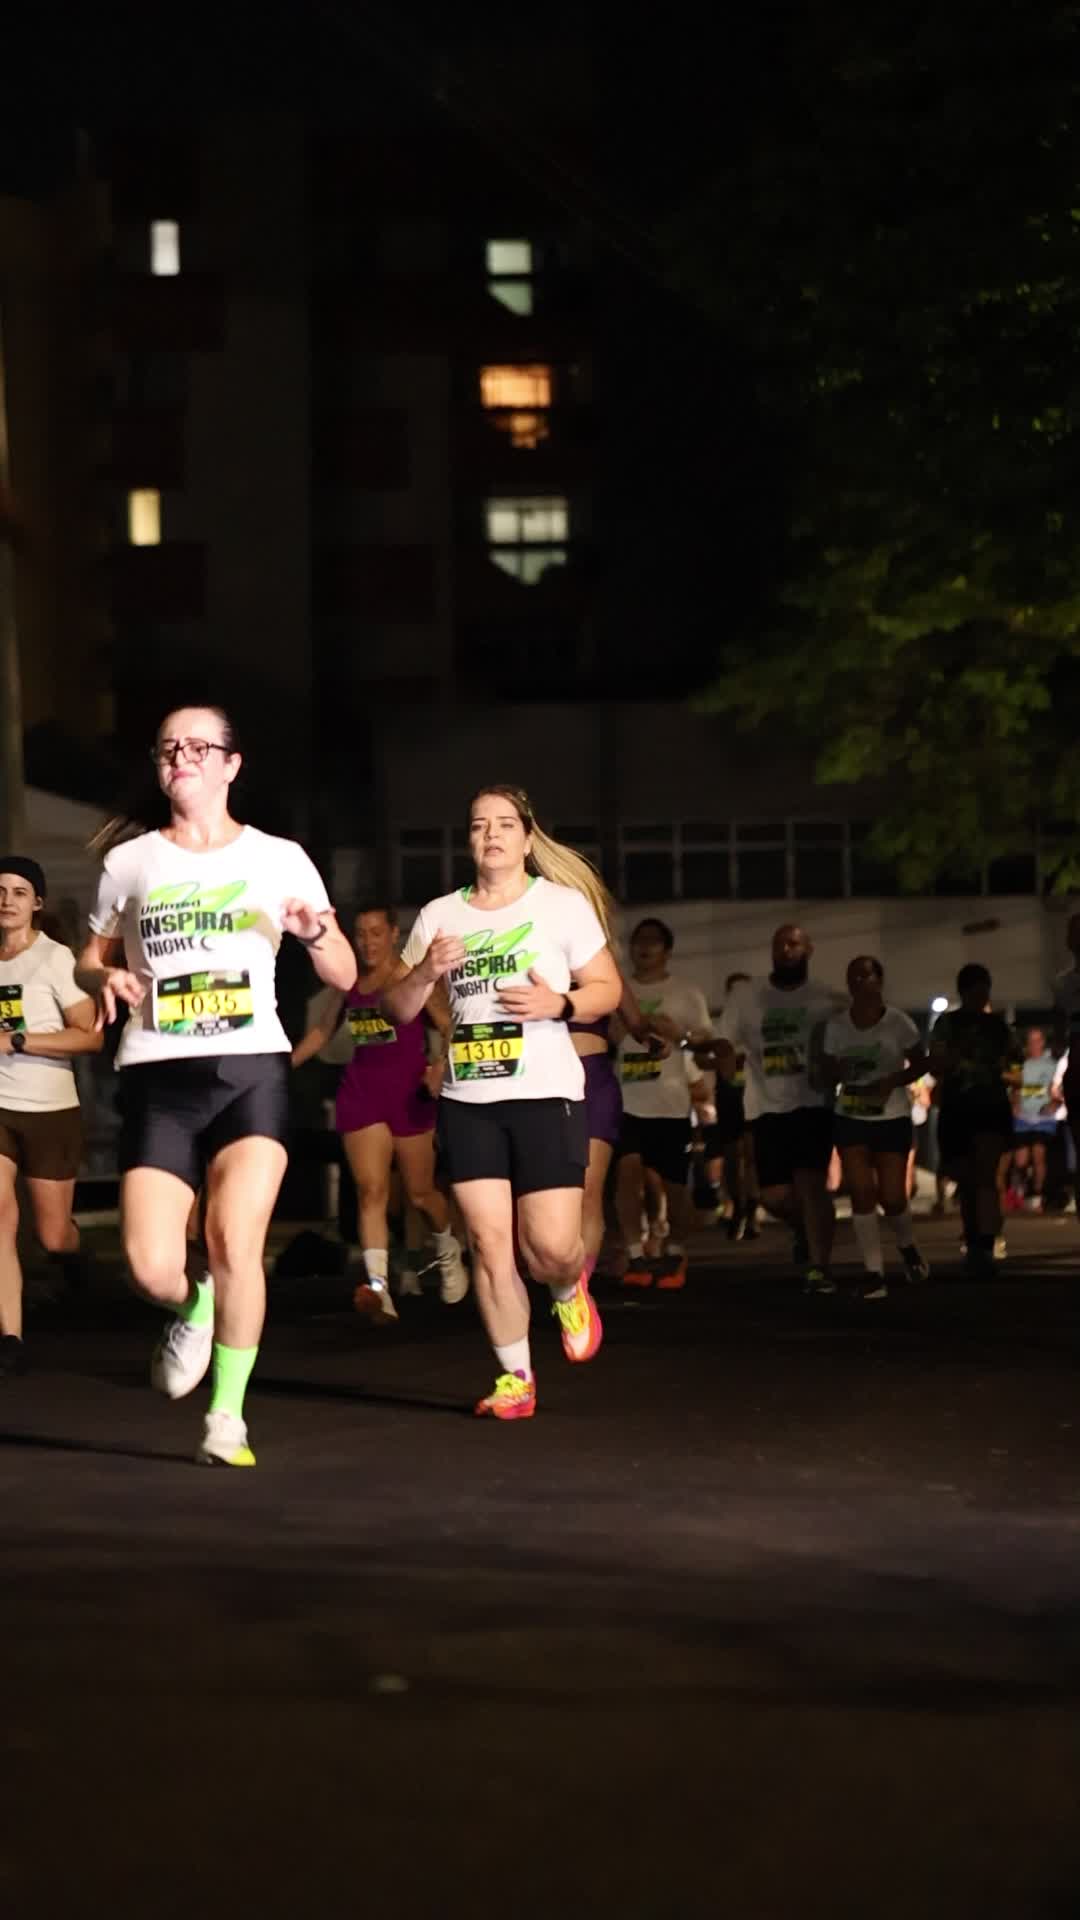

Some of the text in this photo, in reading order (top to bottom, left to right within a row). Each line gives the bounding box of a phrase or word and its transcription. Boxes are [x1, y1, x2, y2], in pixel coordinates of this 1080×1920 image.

[140, 911, 234, 939] INSPIRA
[146, 936, 195, 958] NIGHT
[451, 954, 517, 982] INSPIRA
[454, 978, 489, 999] NIGHT
[179, 992, 237, 1017] 1035
[462, 1040, 511, 1061] 1310
